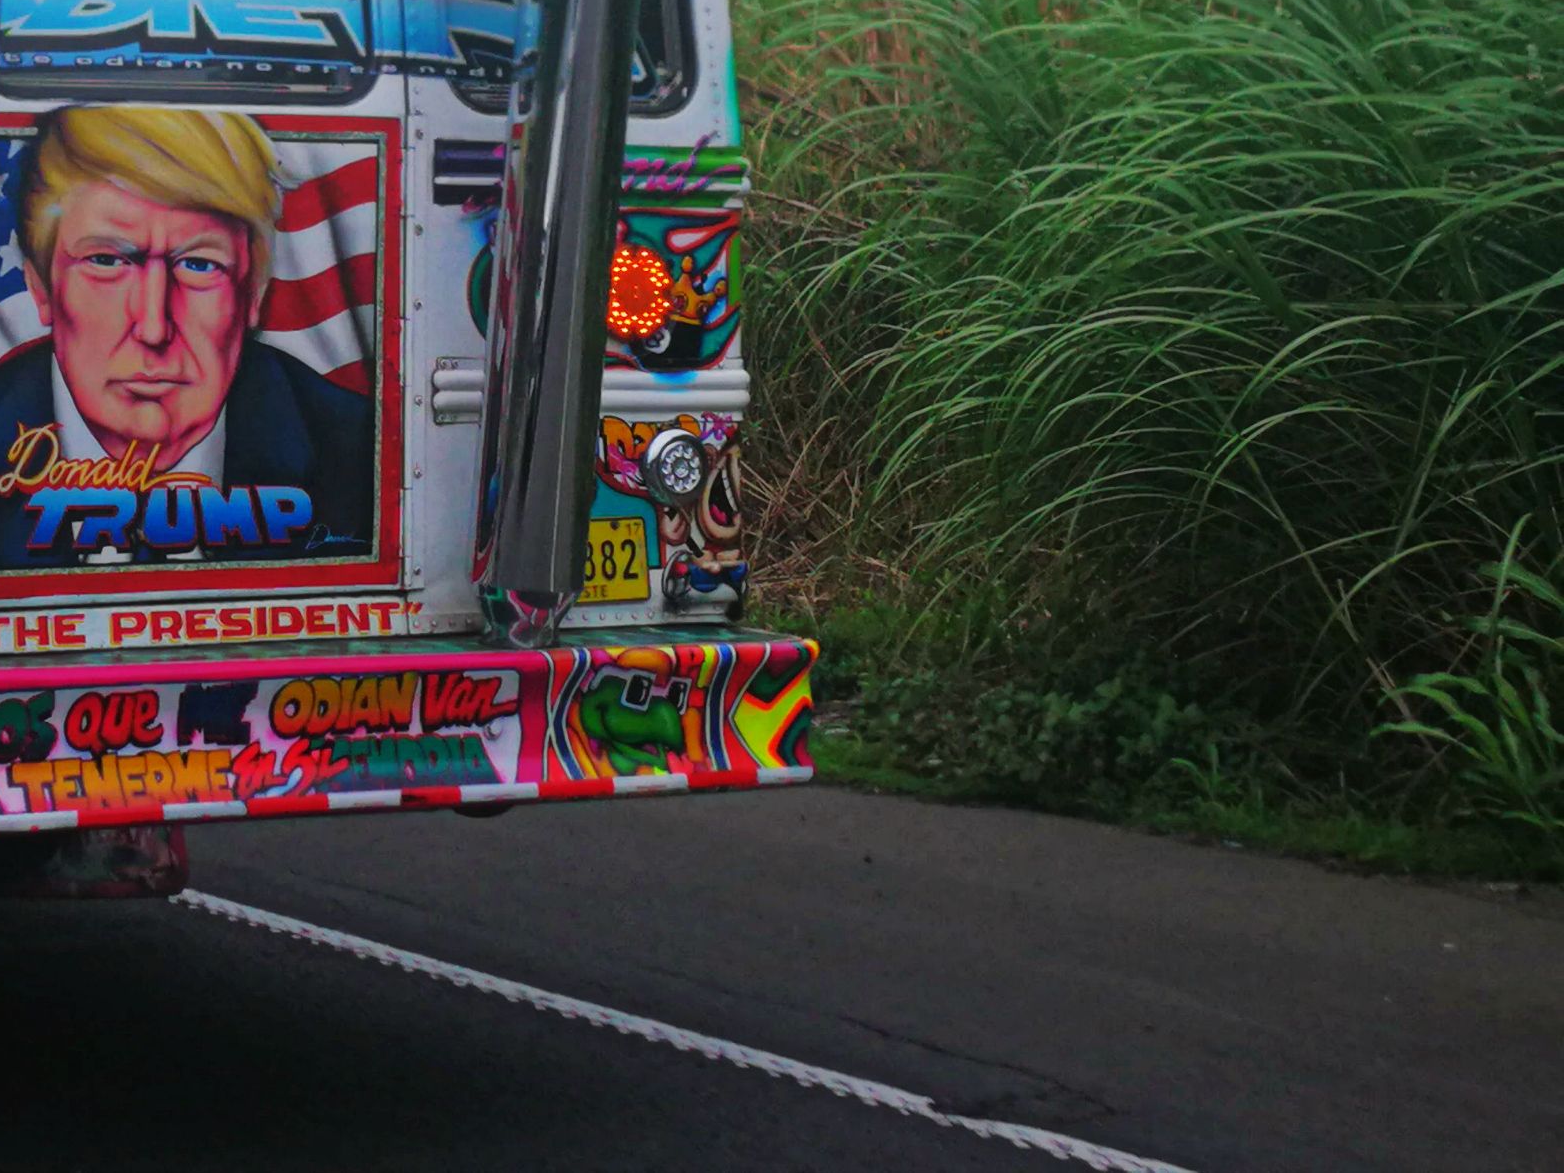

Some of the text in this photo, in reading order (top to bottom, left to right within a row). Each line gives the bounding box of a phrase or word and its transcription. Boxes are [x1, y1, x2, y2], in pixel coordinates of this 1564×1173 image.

[3, 52, 52, 64] te
[76, 55, 204, 70] odian
[226, 59, 274, 72] no
[419, 64, 506, 77] nadi
[25, 485, 313, 550] TRUMP
[626, 522, 642, 536] 17
[269, 673, 418, 739] ODIAN
[9, 749, 234, 812] TENERME
